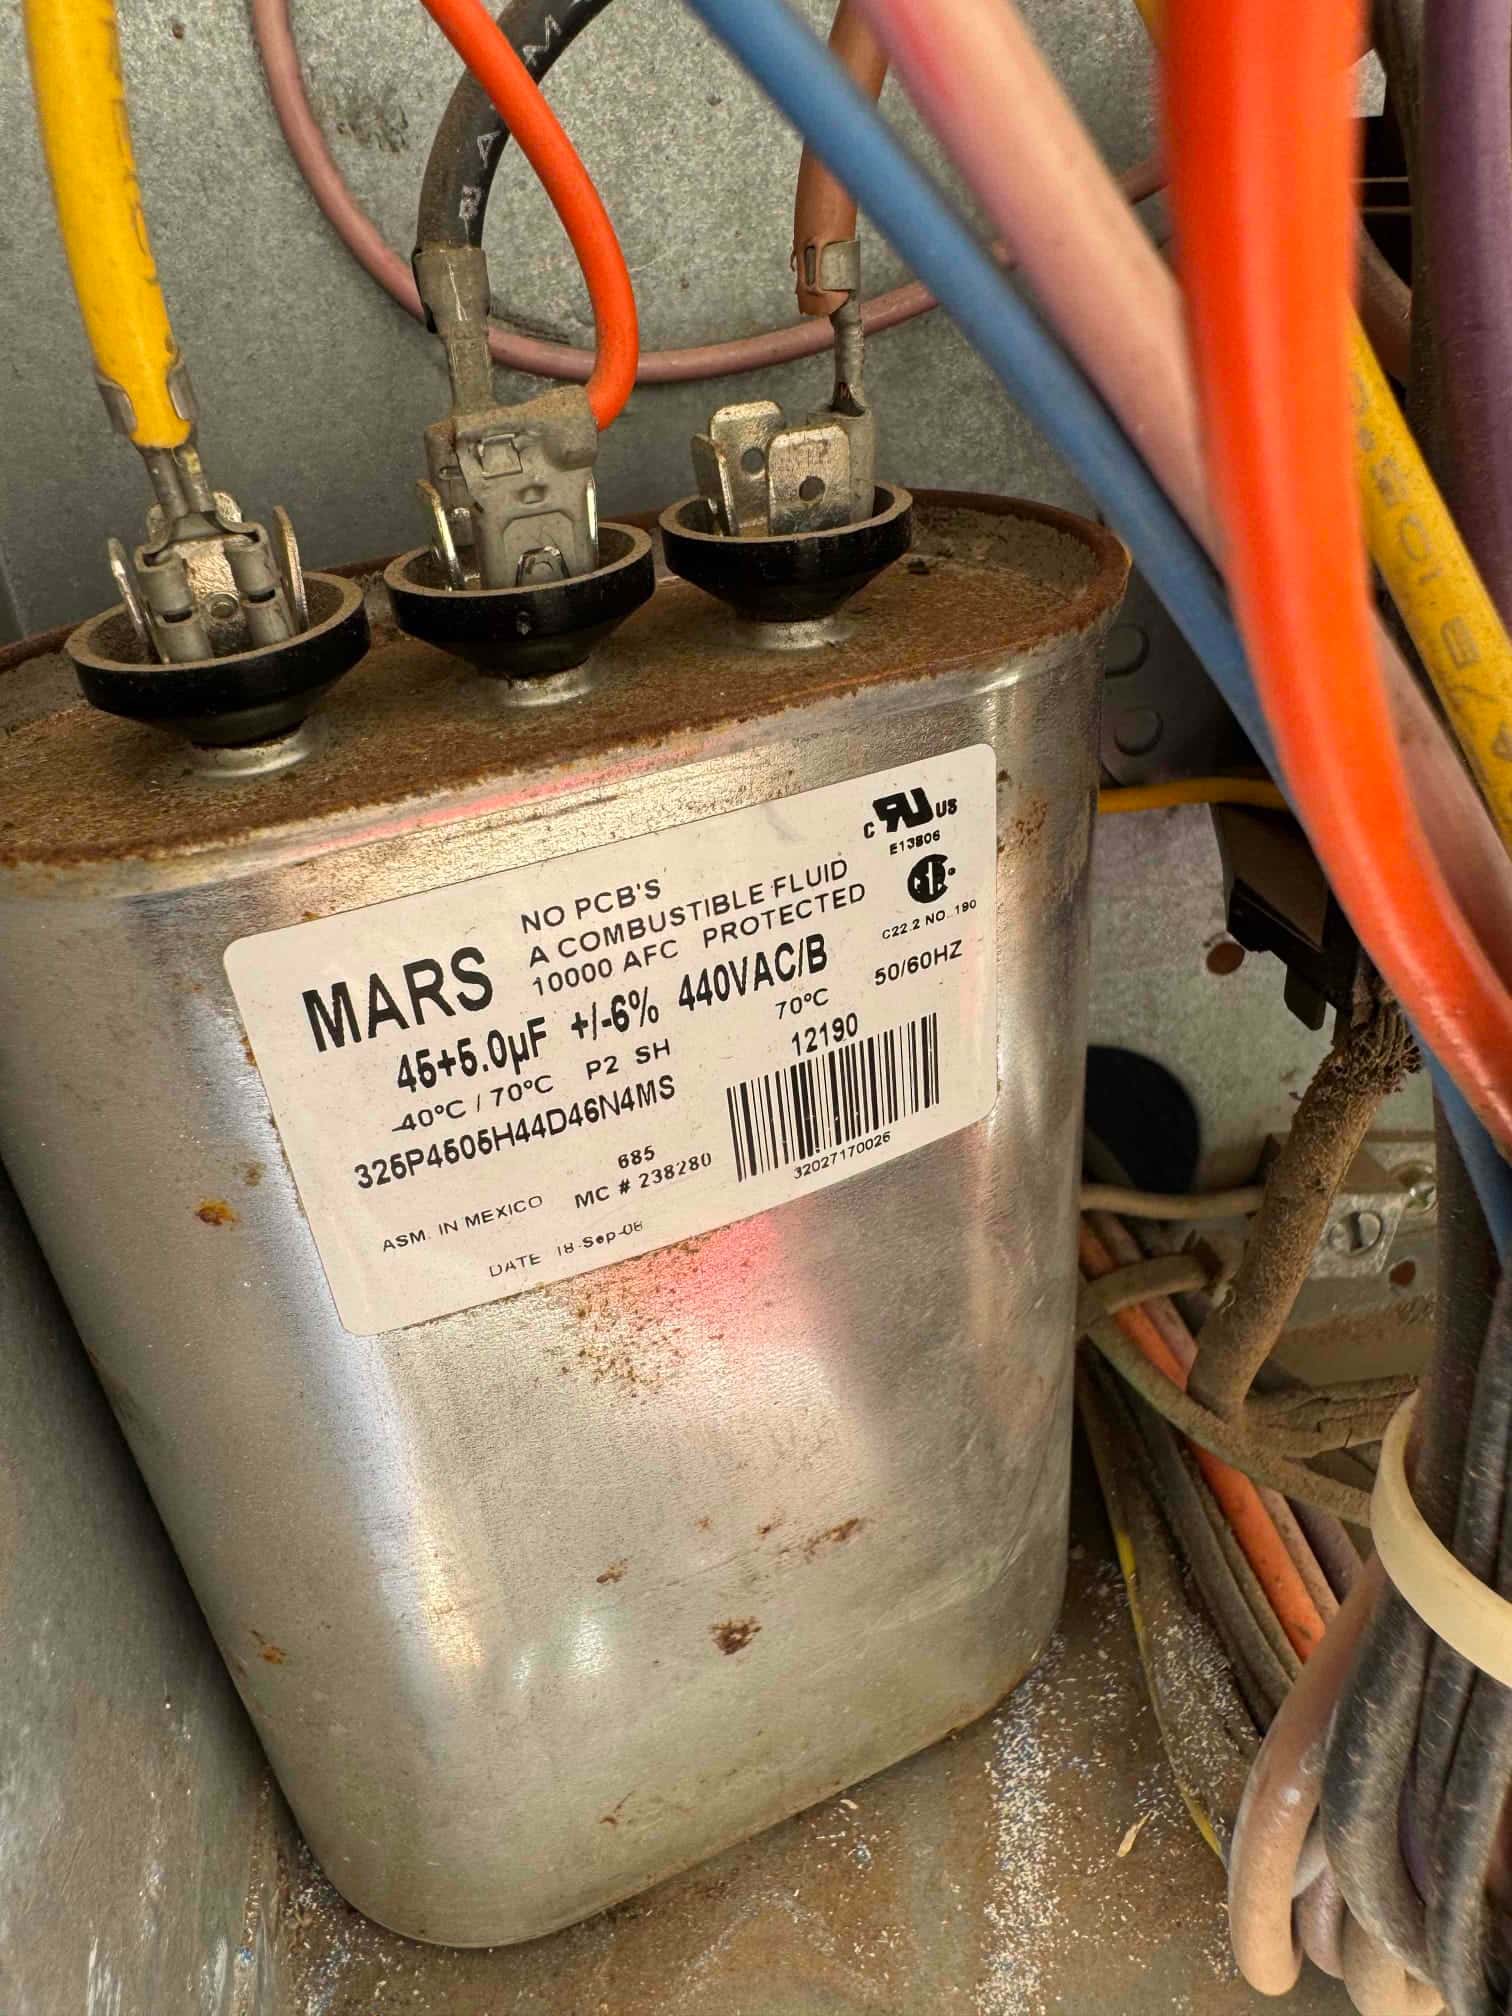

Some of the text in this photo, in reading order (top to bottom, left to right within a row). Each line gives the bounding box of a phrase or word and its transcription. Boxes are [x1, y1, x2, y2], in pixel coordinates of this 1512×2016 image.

[521, 878, 661, 934] NO PCB'S
[529, 859, 848, 968] A COMBUSTIBLE FLUID
[532, 883, 866, 996] 10000 AFC PROTECTED
[882, 919, 920, 939] C22.2
[874, 940, 962, 985] 50/60HZ
[302, 947, 493, 1052] MARS
[571, 986, 659, 1040] +/-6%
[678, 933, 828, 1012] 440VAC/B
[792, 1012, 858, 1056] 12190
[586, 1055, 619, 1080] P2
[635, 1039, 671, 1065] SH
[617, 1145, 656, 1169] 685
[574, 1152, 712, 1209] MC # 238280
[438, 1220, 458, 1237] IN
[465, 1195, 543, 1229] MEXICO
[489, 1253, 541, 1278] DATE
